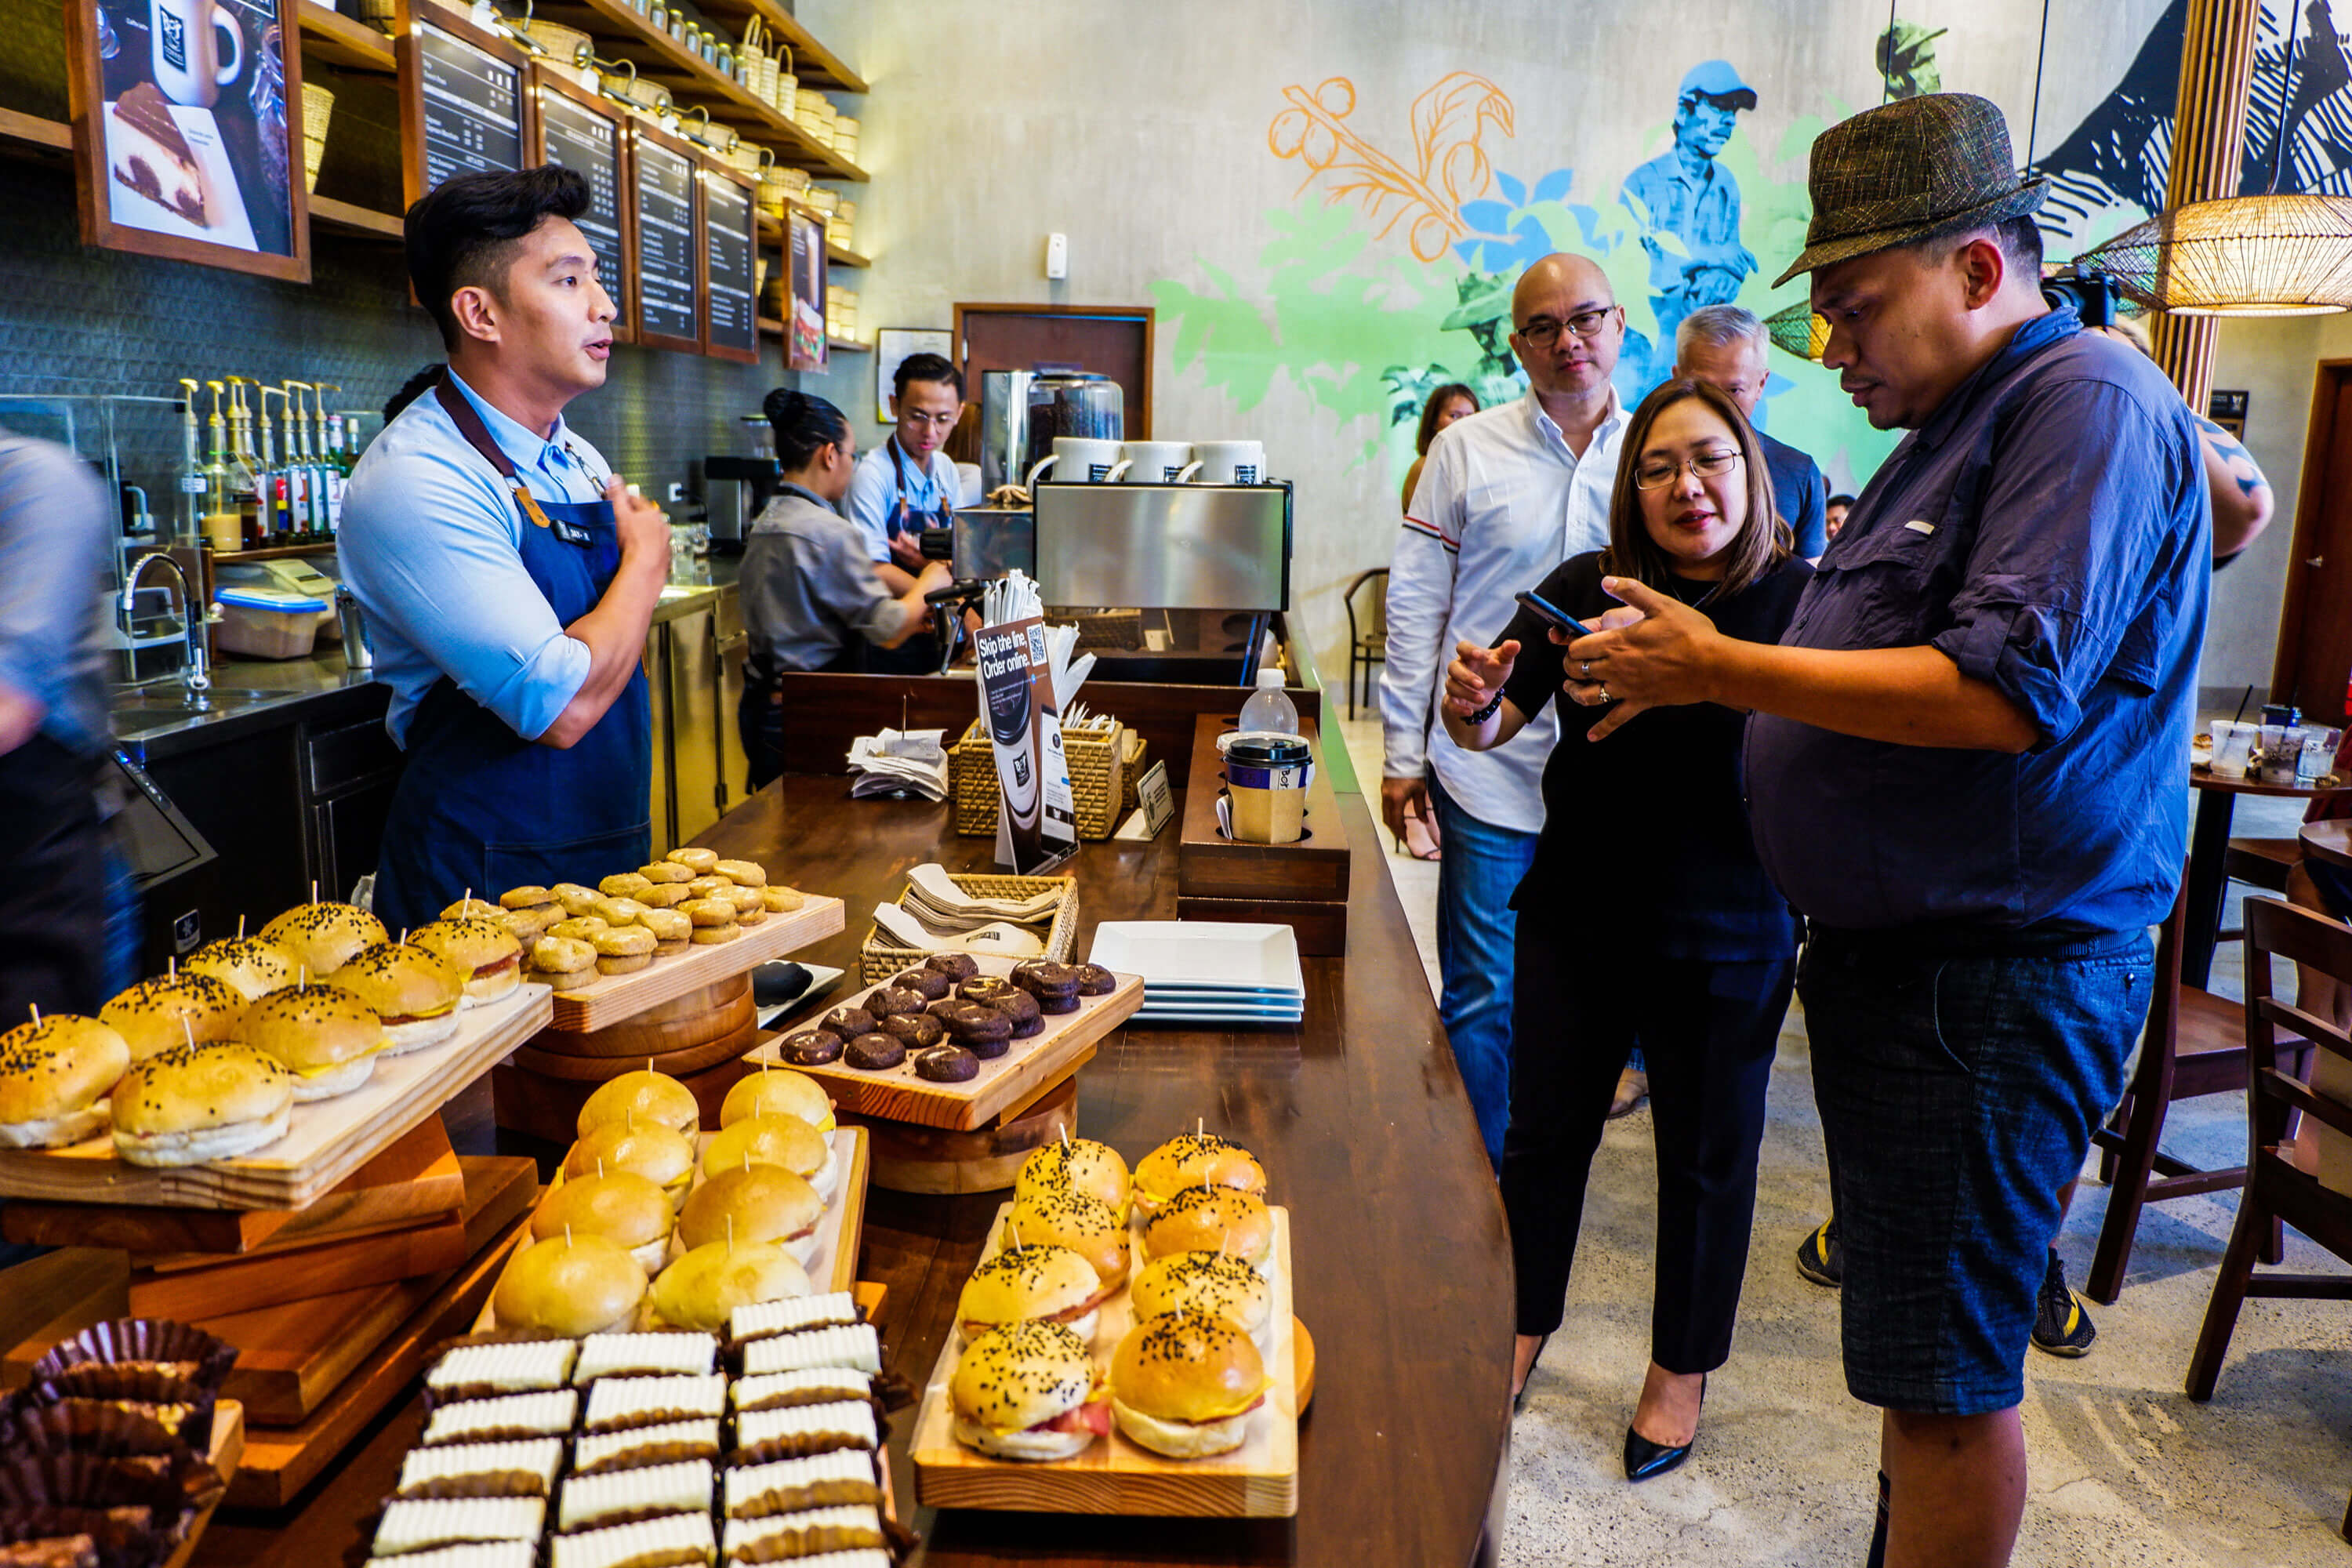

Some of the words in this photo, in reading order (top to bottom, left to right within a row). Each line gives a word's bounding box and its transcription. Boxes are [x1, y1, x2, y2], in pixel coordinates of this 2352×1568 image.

[979, 637, 998, 659] Skip
[997, 633, 1013, 652] the
[1011, 630, 1028, 649] line,
[983, 659, 1006, 680] Order
[1007, 652, 1030, 672] online.
